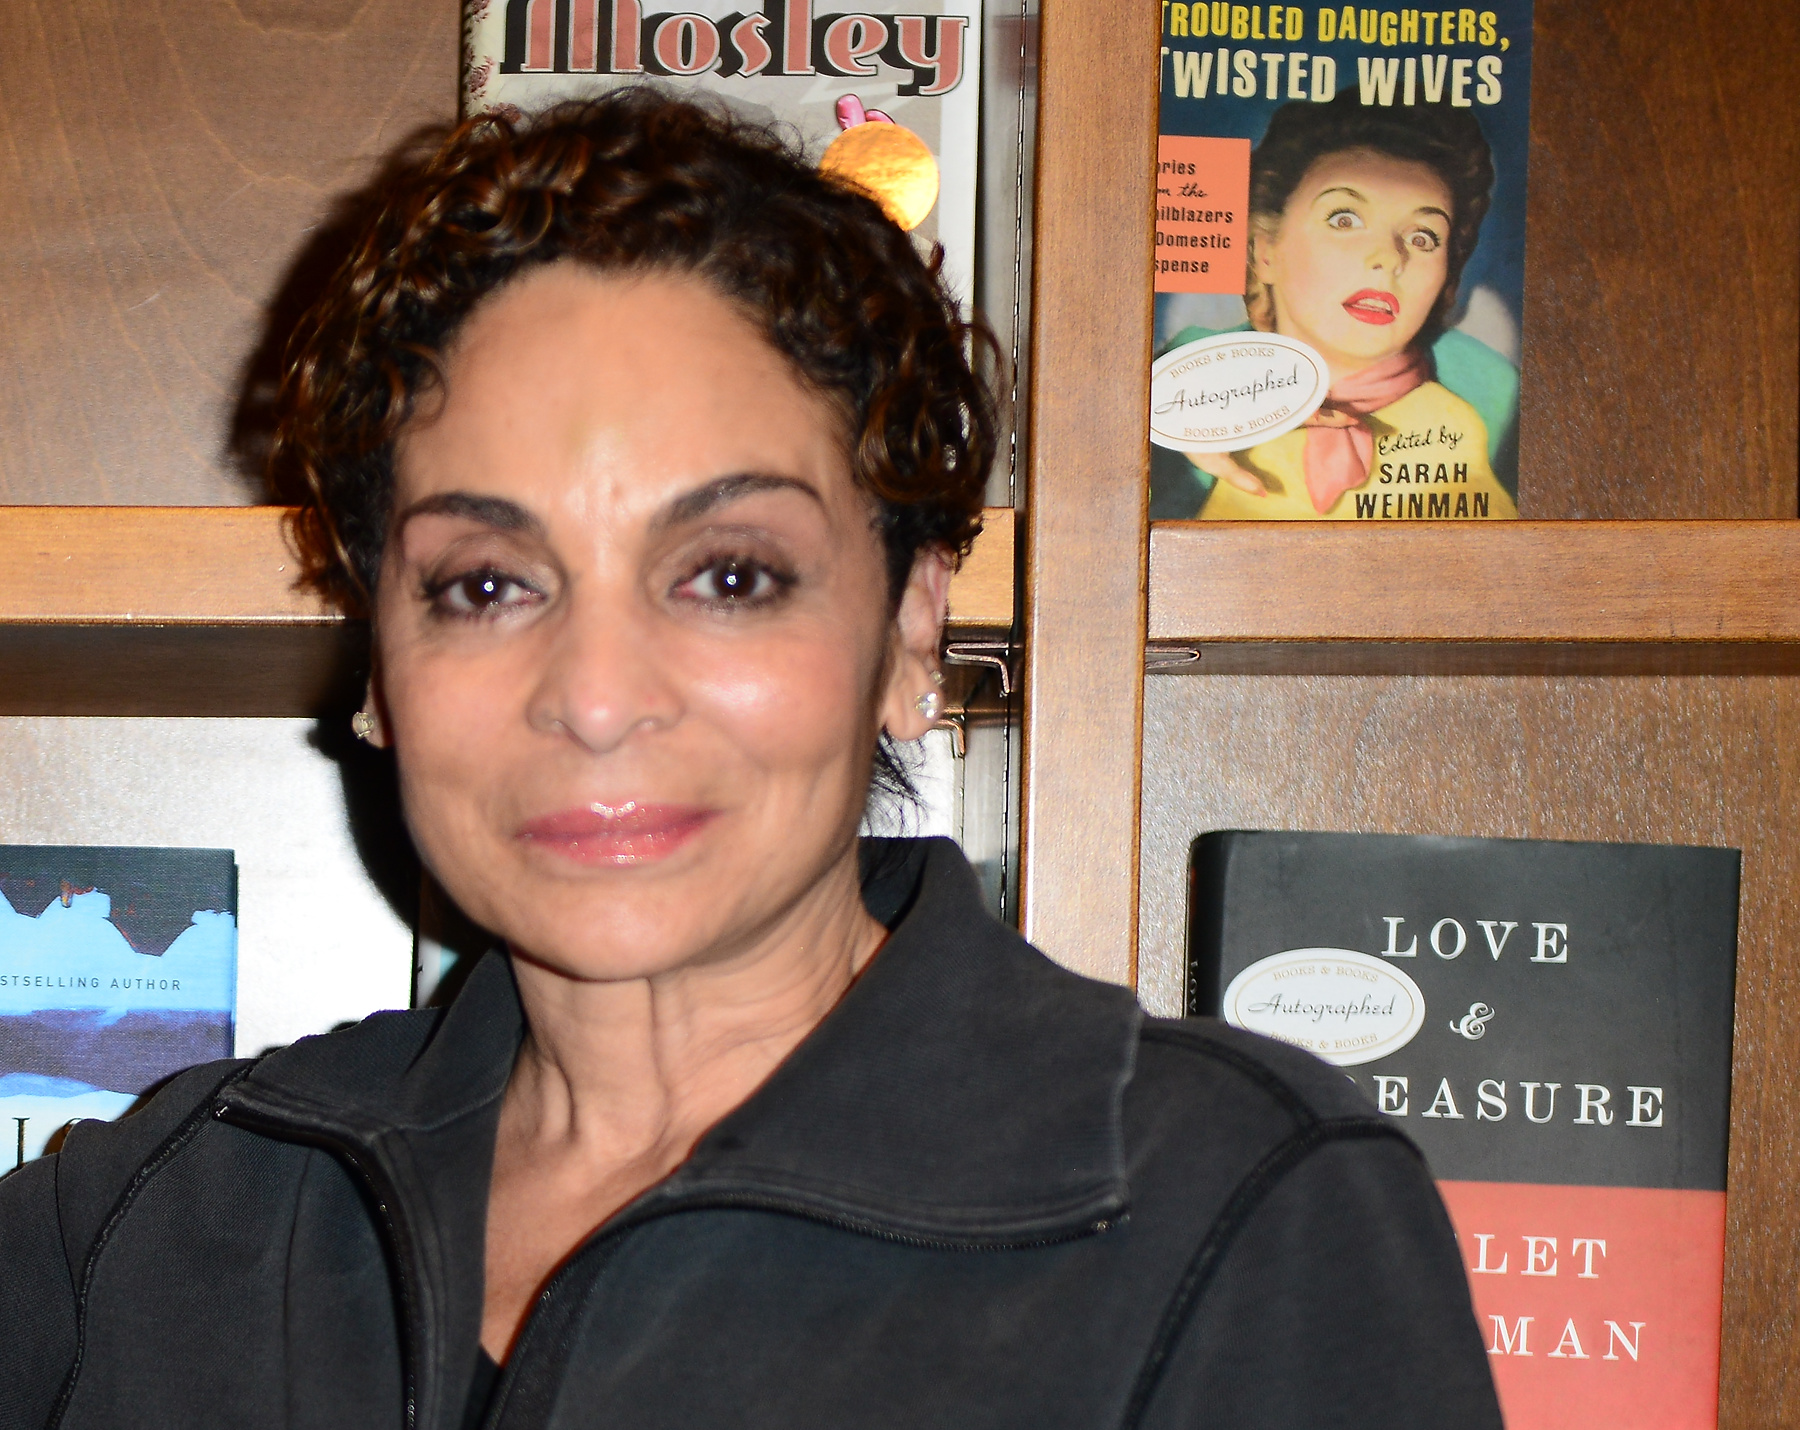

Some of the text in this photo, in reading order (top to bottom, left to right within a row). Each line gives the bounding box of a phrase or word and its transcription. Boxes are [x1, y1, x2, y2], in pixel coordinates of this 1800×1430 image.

[1318, 6, 1510, 52] DAUGHTERS,
[1357, 54, 1503, 107] WIVES
[1157, 160, 1196, 175] ries
[1156, 206, 1233, 224] ilblazers
[1156, 232, 1231, 249] Domestic
[1170, 355, 1212, 379] BOOKS
[1231, 347, 1275, 358] BOOKS
[1154, 363, 1299, 415] Autographed
[1184, 426, 1228, 438] BOOKS
[1248, 405, 1291, 430] BOOKS
[1379, 425, 1464, 455] Edited by
[1380, 463, 1467, 484] SARAH
[1355, 492, 1489, 519] WEINMAN
[1381, 916, 1568, 964] LOVE
[110, 977, 182, 991] AUTHOR
[1272, 966, 1315, 981] BOOKS
[1336, 966, 1379, 982] BOOKS
[1247, 993, 1396, 1022] Autographed
[1449, 1001, 1495, 1040] &
[1335, 1033, 1378, 1049] BOOKS
[1346, 1074, 1664, 1127] EASURE
[1456, 1233, 1606, 1279] LET
